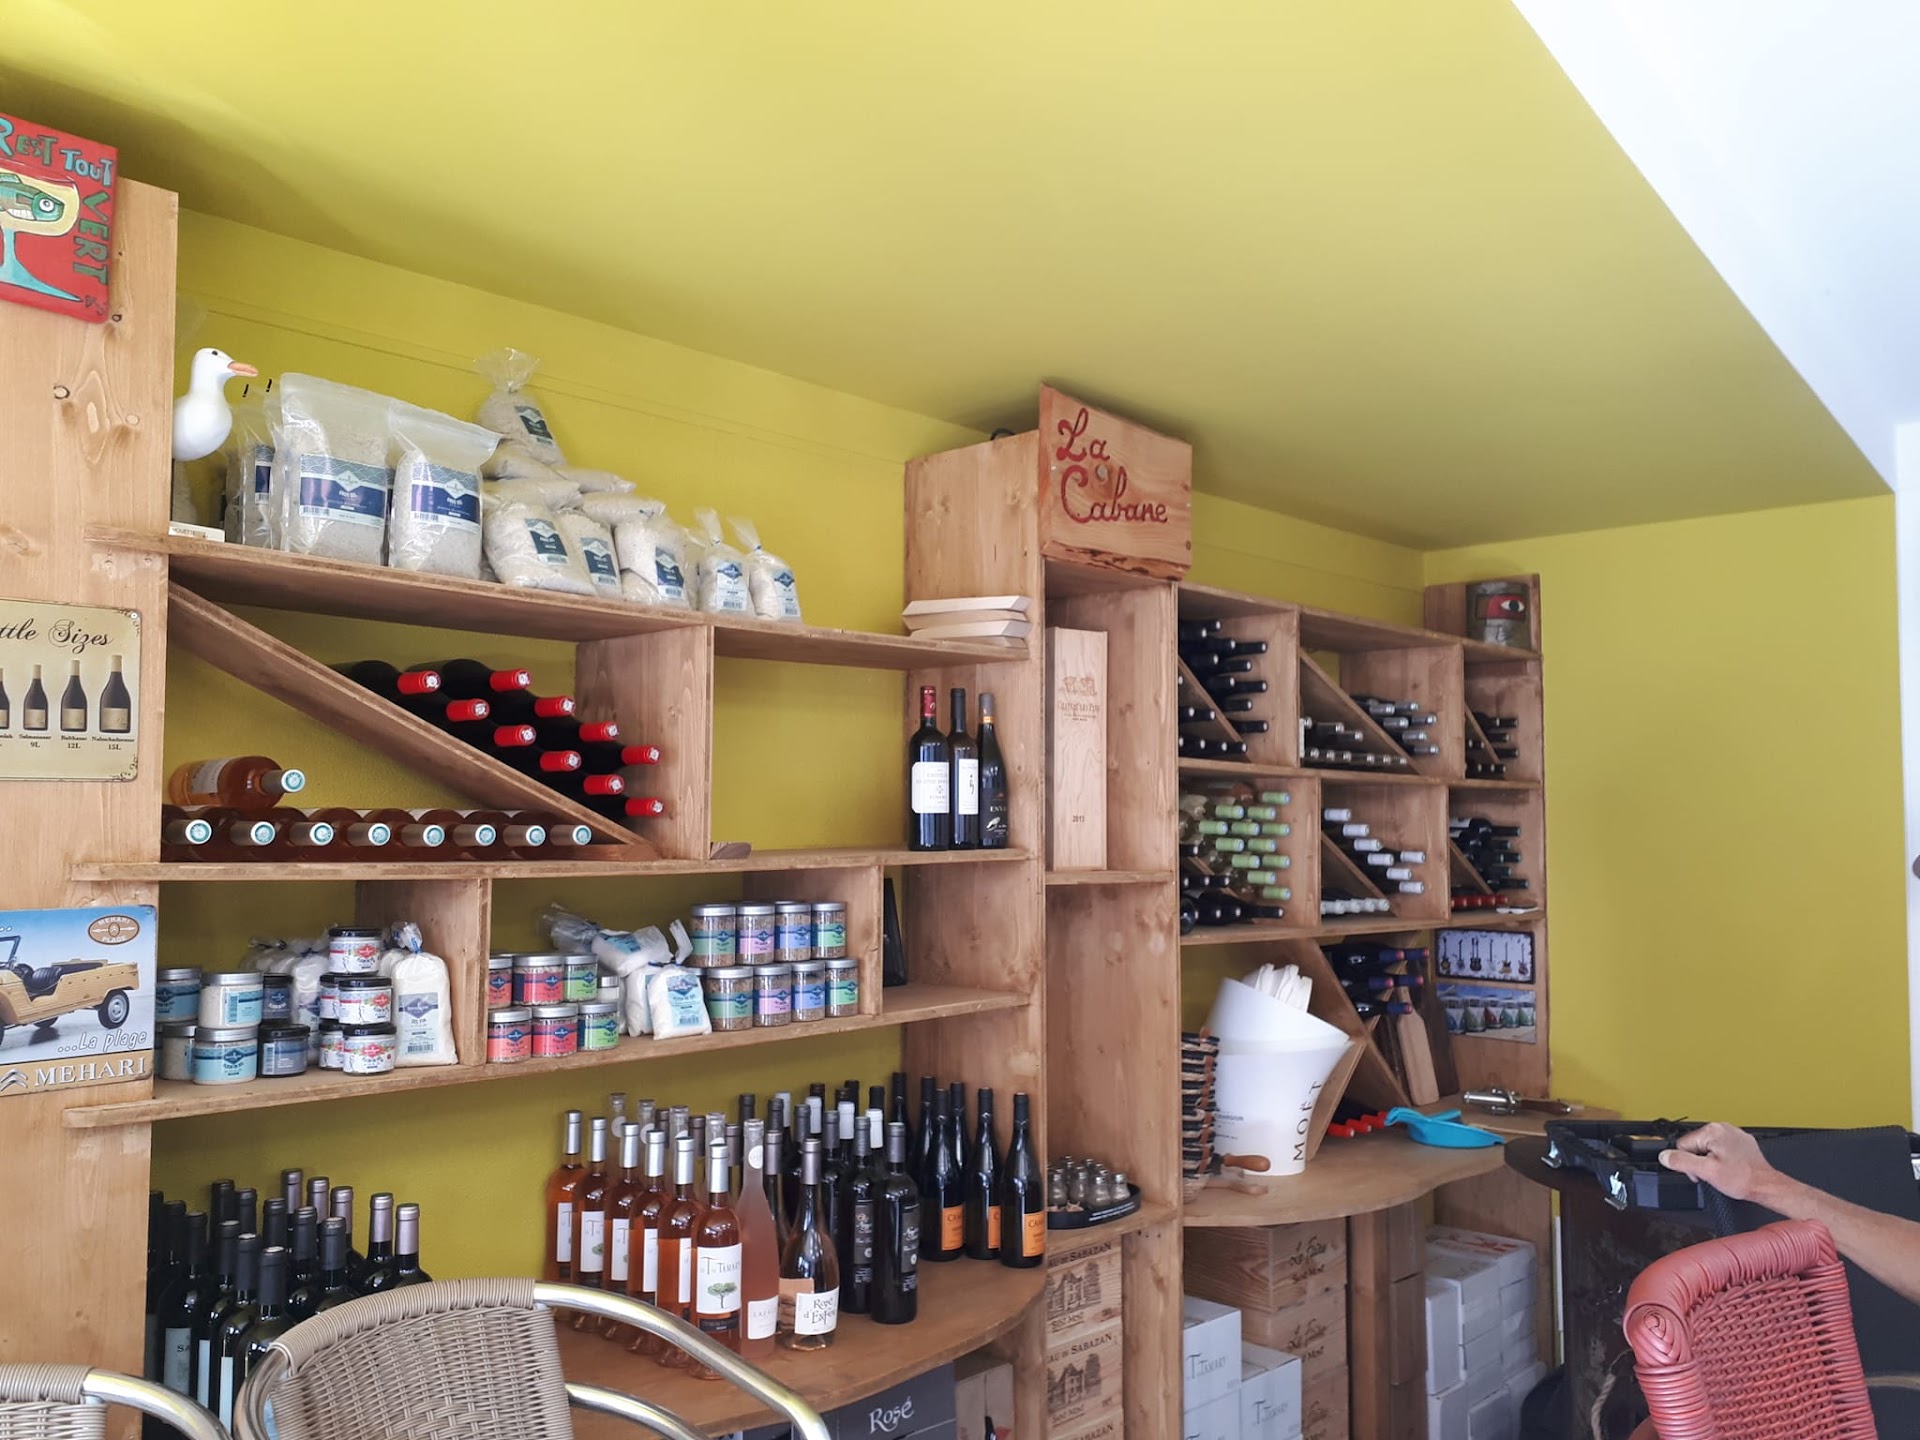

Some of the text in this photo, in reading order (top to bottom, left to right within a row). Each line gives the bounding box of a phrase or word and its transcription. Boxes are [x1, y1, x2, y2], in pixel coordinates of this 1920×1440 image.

[73, 191, 109, 285] VERT
[1056, 407, 1110, 462] La
[1060, 464, 1168, 524] Cabane
[48, 618, 114, 654] Sizes
[103, 1029, 147, 1053] plage
[34, 1056, 147, 1087] MEHARI
[1070, 1332, 1113, 1355] SABAZAN
[868, 1395, 915, 1435] Rosé
